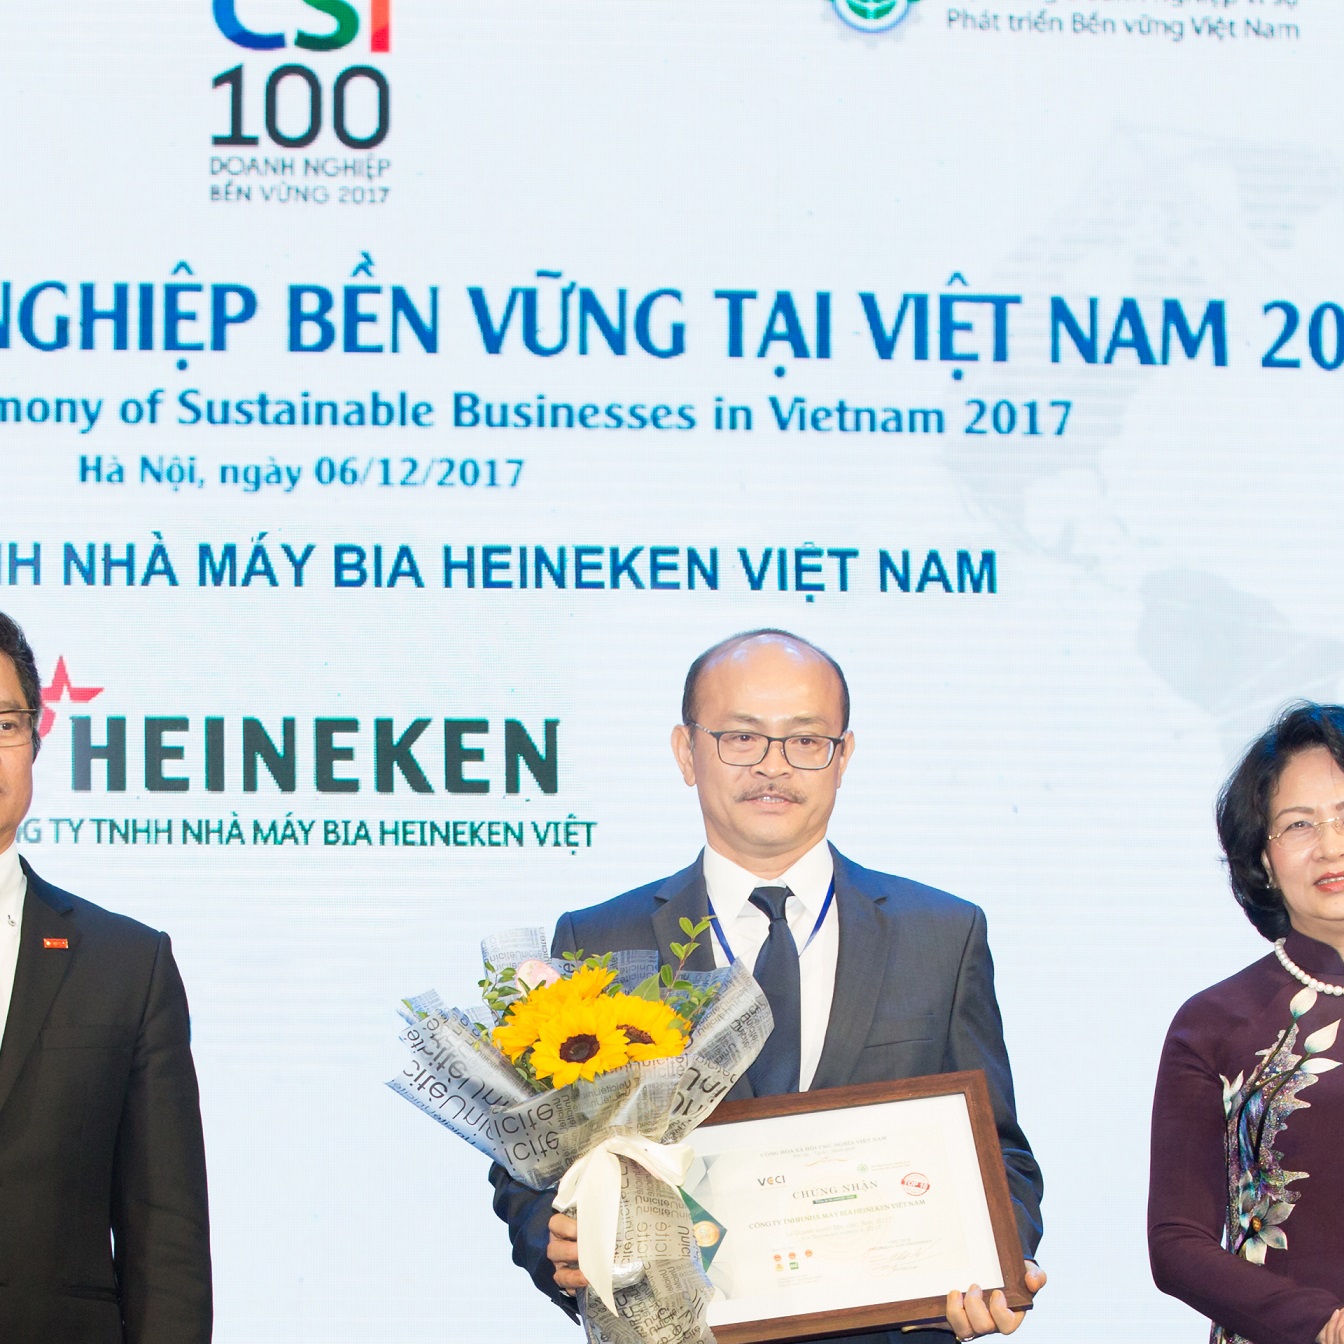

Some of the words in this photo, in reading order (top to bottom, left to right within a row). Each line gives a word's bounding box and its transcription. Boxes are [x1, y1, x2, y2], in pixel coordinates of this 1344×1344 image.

[1245, 17, 1301, 39] Nam
[211, 62, 391, 150] 100
[210, 155, 295, 177] DOANH
[339, 186, 391, 204] 2017
[287, 250, 439, 354] BỀN
[466, 269, 686, 359] VỮNG
[713, 289, 832, 378] TẠI
[858, 271, 1023, 381] VIỆT
[1050, 295, 1229, 367] NAM
[119, 388, 165, 425] of
[177, 388, 434, 428] Sustainable
[453, 391, 697, 430] Businesses
[714, 396, 753, 431] in
[768, 396, 945, 434] Vietnam
[964, 399, 1073, 436] 2017
[79, 455, 124, 483] Hà
[140, 455, 204, 492] Nội,
[220, 456, 302, 492] ngày
[314, 456, 524, 488] 06/12/2017
[63, 530, 179, 586] NHÀ
[198, 531, 316, 587] MÁY
[333, 543, 425, 588] BIA
[443, 544, 719, 590] HEINEKEN
[737, 541, 860, 603] VIỆT
[878, 549, 998, 594] NAM
[71, 715, 560, 794] HEINEKEN
[49, 818, 84, 844] TY
[89, 818, 172, 845] TNHH
[182, 811, 246, 846] NHÀ
[252, 811, 316, 847] MÁY
[323, 819, 373, 846] BIA
[379, 819, 524, 848] HEINEKEN
[531, 813, 598, 855] VIỆT
[757, 1175, 786, 1187] VCCI
